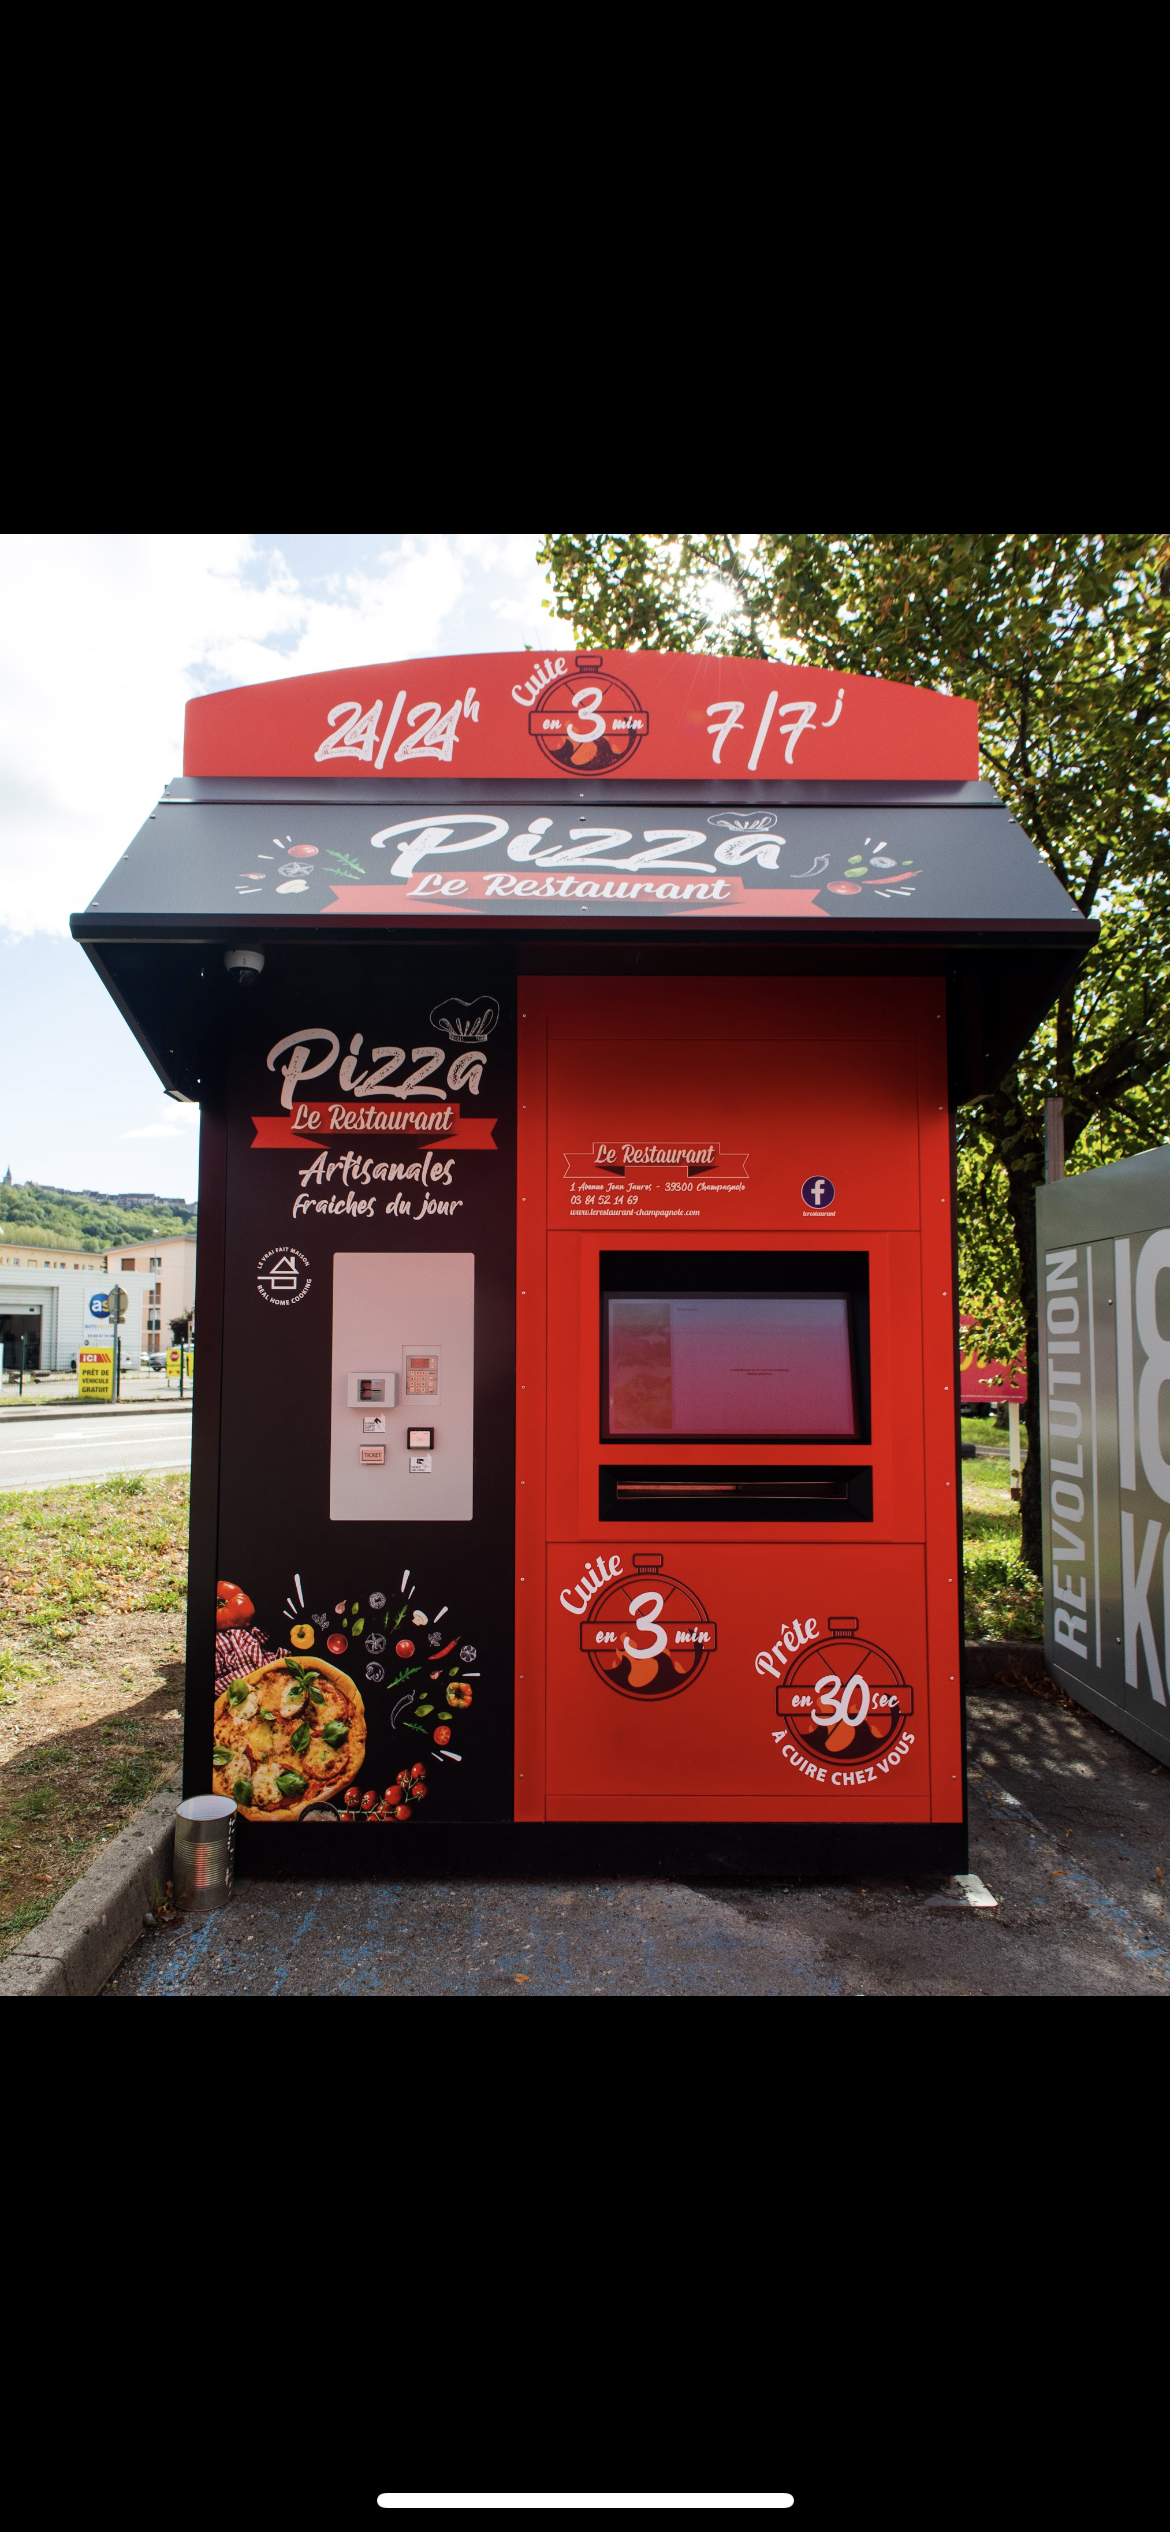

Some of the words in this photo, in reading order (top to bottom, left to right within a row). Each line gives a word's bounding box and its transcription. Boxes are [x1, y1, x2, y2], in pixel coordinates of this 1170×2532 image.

[511, 657, 568, 707] Cuite
[542, 719, 562, 730] en
[566, 687, 606, 743] 3
[612, 716, 643, 730] min
[370, 814, 786, 877] Pizza
[406, 873, 468, 897] Le
[483, 873, 732, 900] Restaurant
[266, 1028, 487, 1110] Pizza
[291, 1104, 322, 1130] Le
[328, 1103, 454, 1131] Restaurant
[298, 1151, 456, 1187] Artisanales
[594, 1143, 617, 1164] Le
[621, 1143, 716, 1165] Restaurant
[386, 1192, 411, 1215] du
[413, 1192, 463, 1220] jour
[569, 1182, 576, 1192] 1
[578, 1182, 604, 1191] Avenue
[605, 1182, 625, 1193] Jean
[664, 1182, 694, 1192] 39300
[696, 1182, 746, 1193] Champagnole
[570, 1195, 582, 1205] 03
[584, 1195, 595, 1205] 84
[598, 1195, 612, 1205] 52
[613, 1195, 624, 1205] 14
[626, 1195, 639, 1205] 69
[569, 1208, 700, 1218] www.lerestaurant-champagnole.com
[257, 1261, 264, 1270] LE
[261, 1250, 275, 1262] VRAI
[290, 1248, 310, 1267] MAISON
[257, 1284, 270, 1301] REAL
[269, 1297, 290, 1305] HOME
[291, 1278, 312, 1304] COOKING
[82, 1368, 99, 1376] PRÊT
[1045, 1248, 1088, 1660] REVOLUTION
[560, 1555, 623, 1615] Cuite
[595, 1630, 617, 1643] en
[623, 1591, 668, 1659] 3
[675, 1627, 711, 1643] min
[1121, 1511, 1170, 1707] K
[755, 1618, 820, 1679] Prête
[791, 1695, 813, 1707] en
[811, 1674, 870, 1727] 30
[872, 1692, 900, 1710] sec
[781, 1744, 828, 1783] CUIRE
[831, 1766, 878, 1786] CHEZ
[876, 1731, 916, 1774] VOUS
